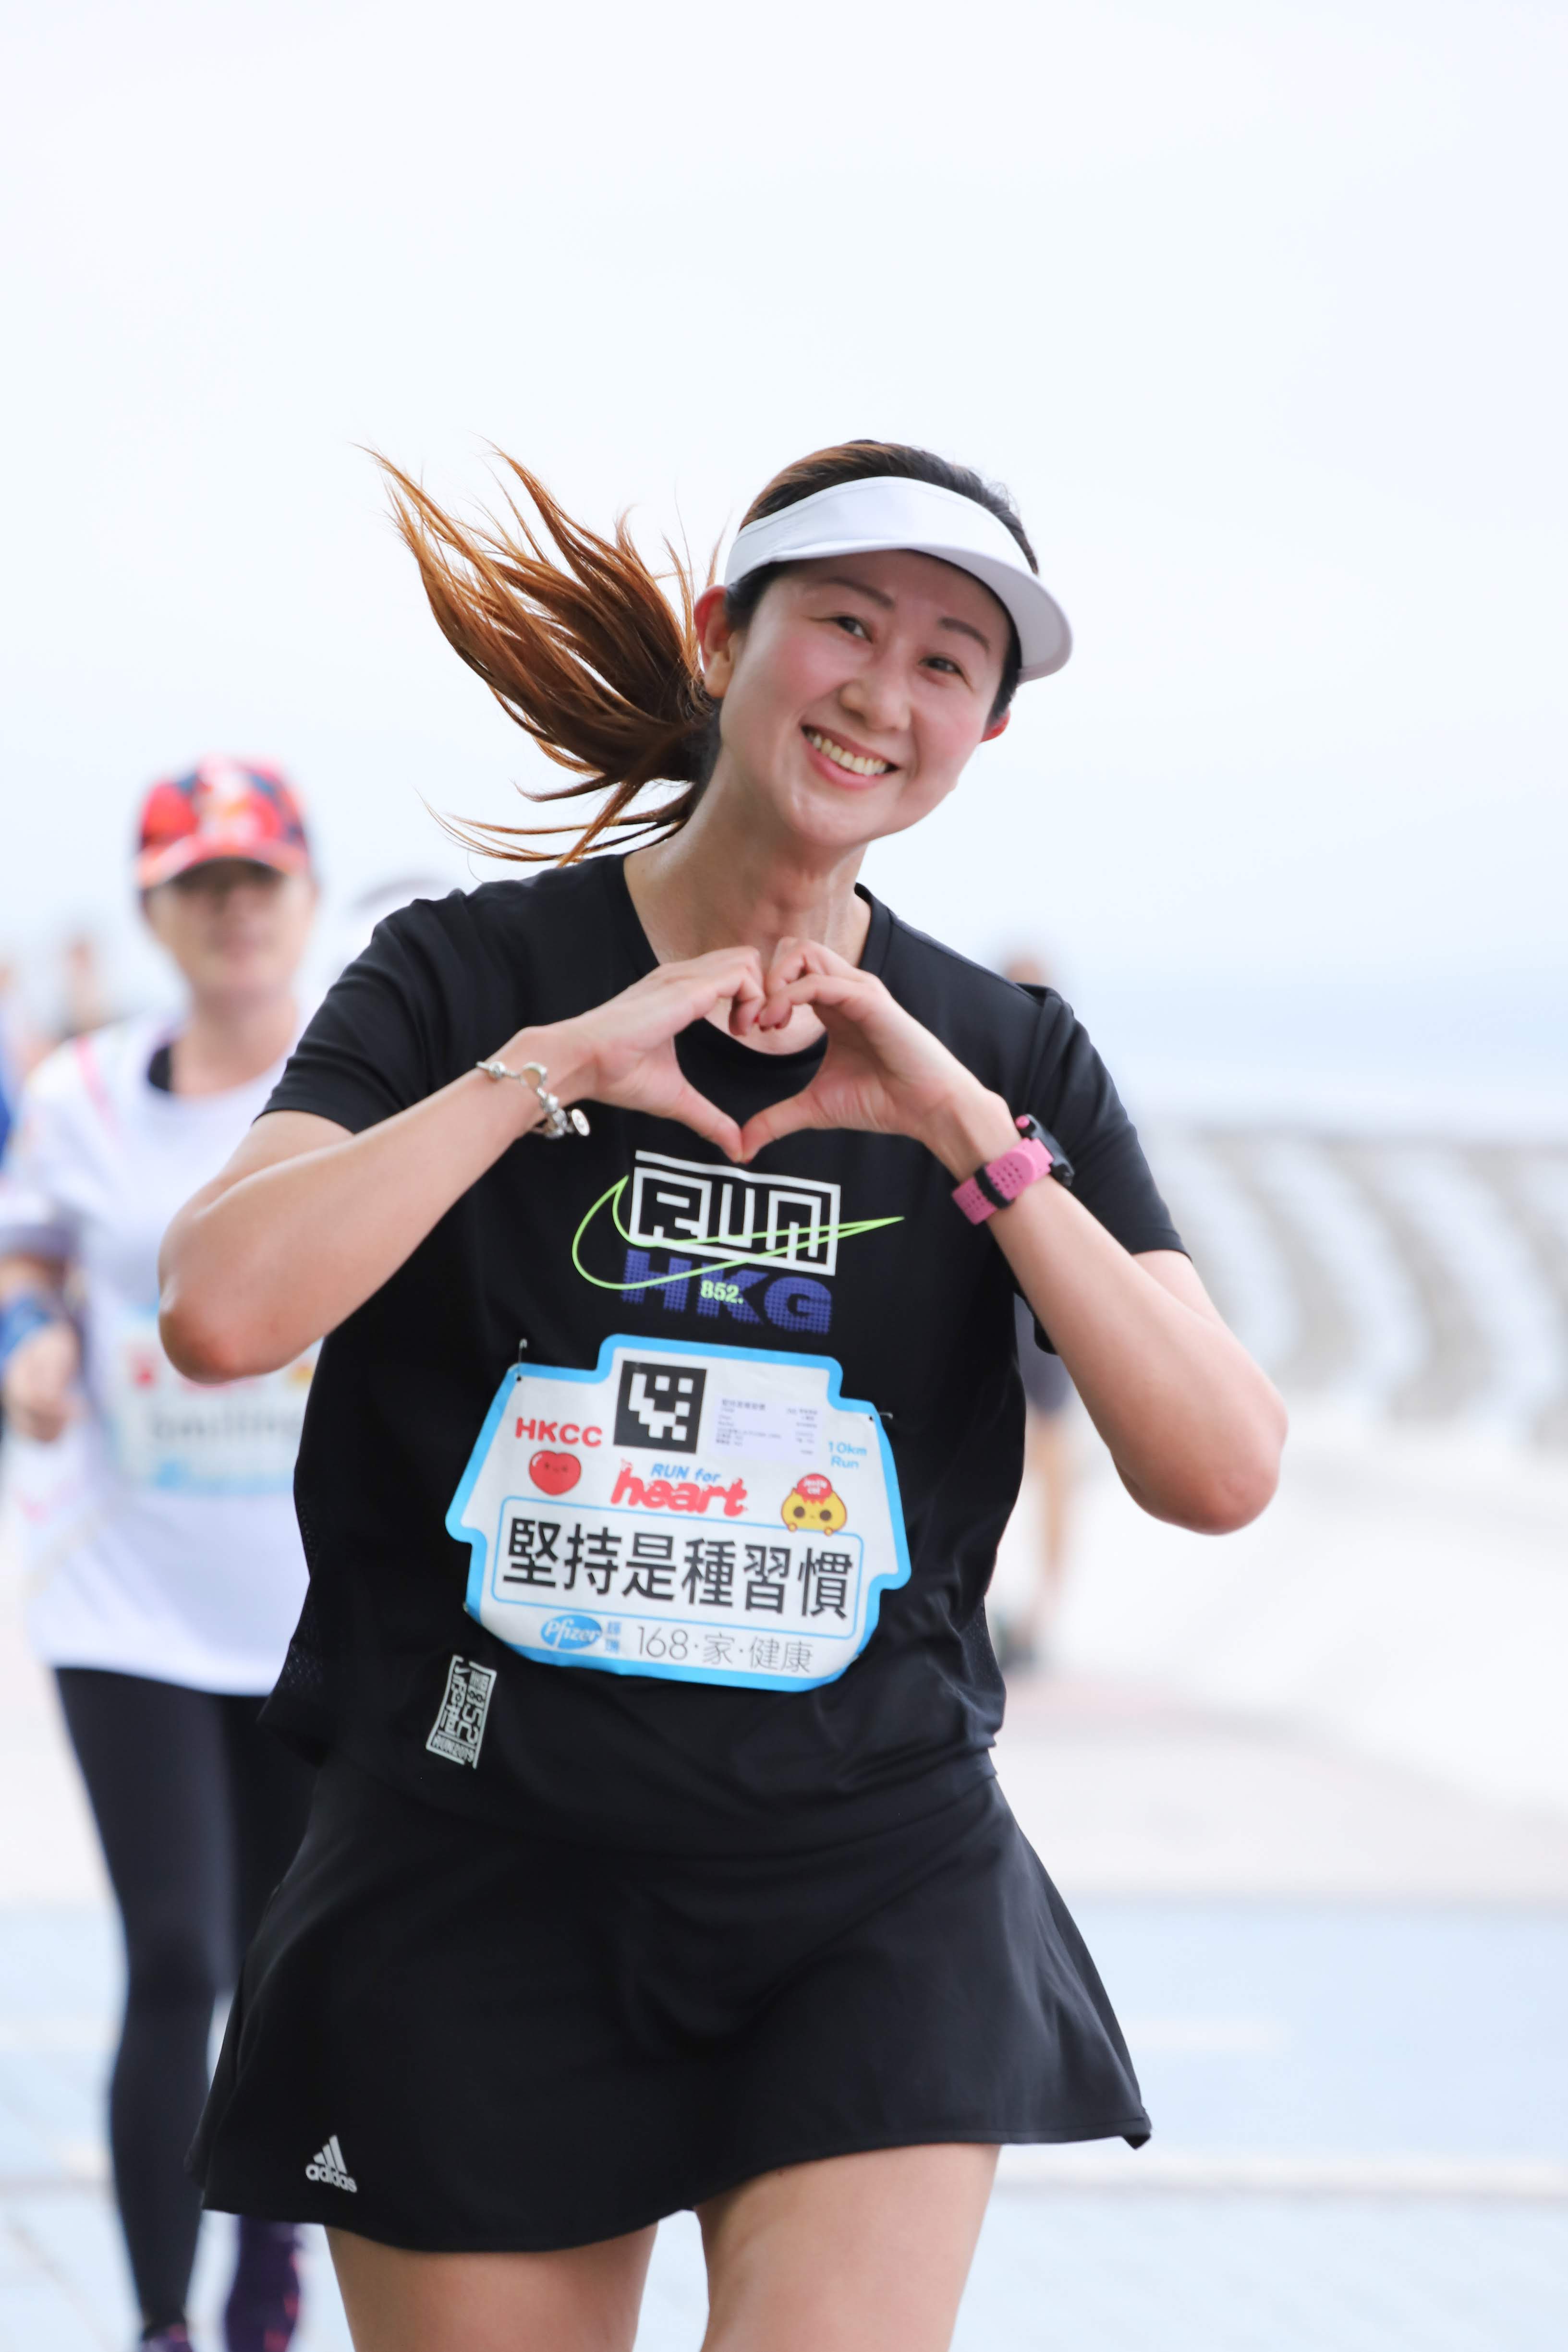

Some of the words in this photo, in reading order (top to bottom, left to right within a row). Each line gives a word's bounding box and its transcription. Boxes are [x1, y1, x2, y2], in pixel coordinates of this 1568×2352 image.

[621, 1249, 832, 1334] HKG
[516, 1417, 602, 1447] HKCC
[651, 1463, 689, 1480] RUN
[694, 1468, 721, 1482] for
[831, 1455, 859, 1469] Run
[611, 1465, 748, 1517] heart
[503, 1517, 852, 1619] 堅持是種習慣
[545, 1618, 600, 1649] Pfizer
[305, 2163, 357, 2193] adidas
